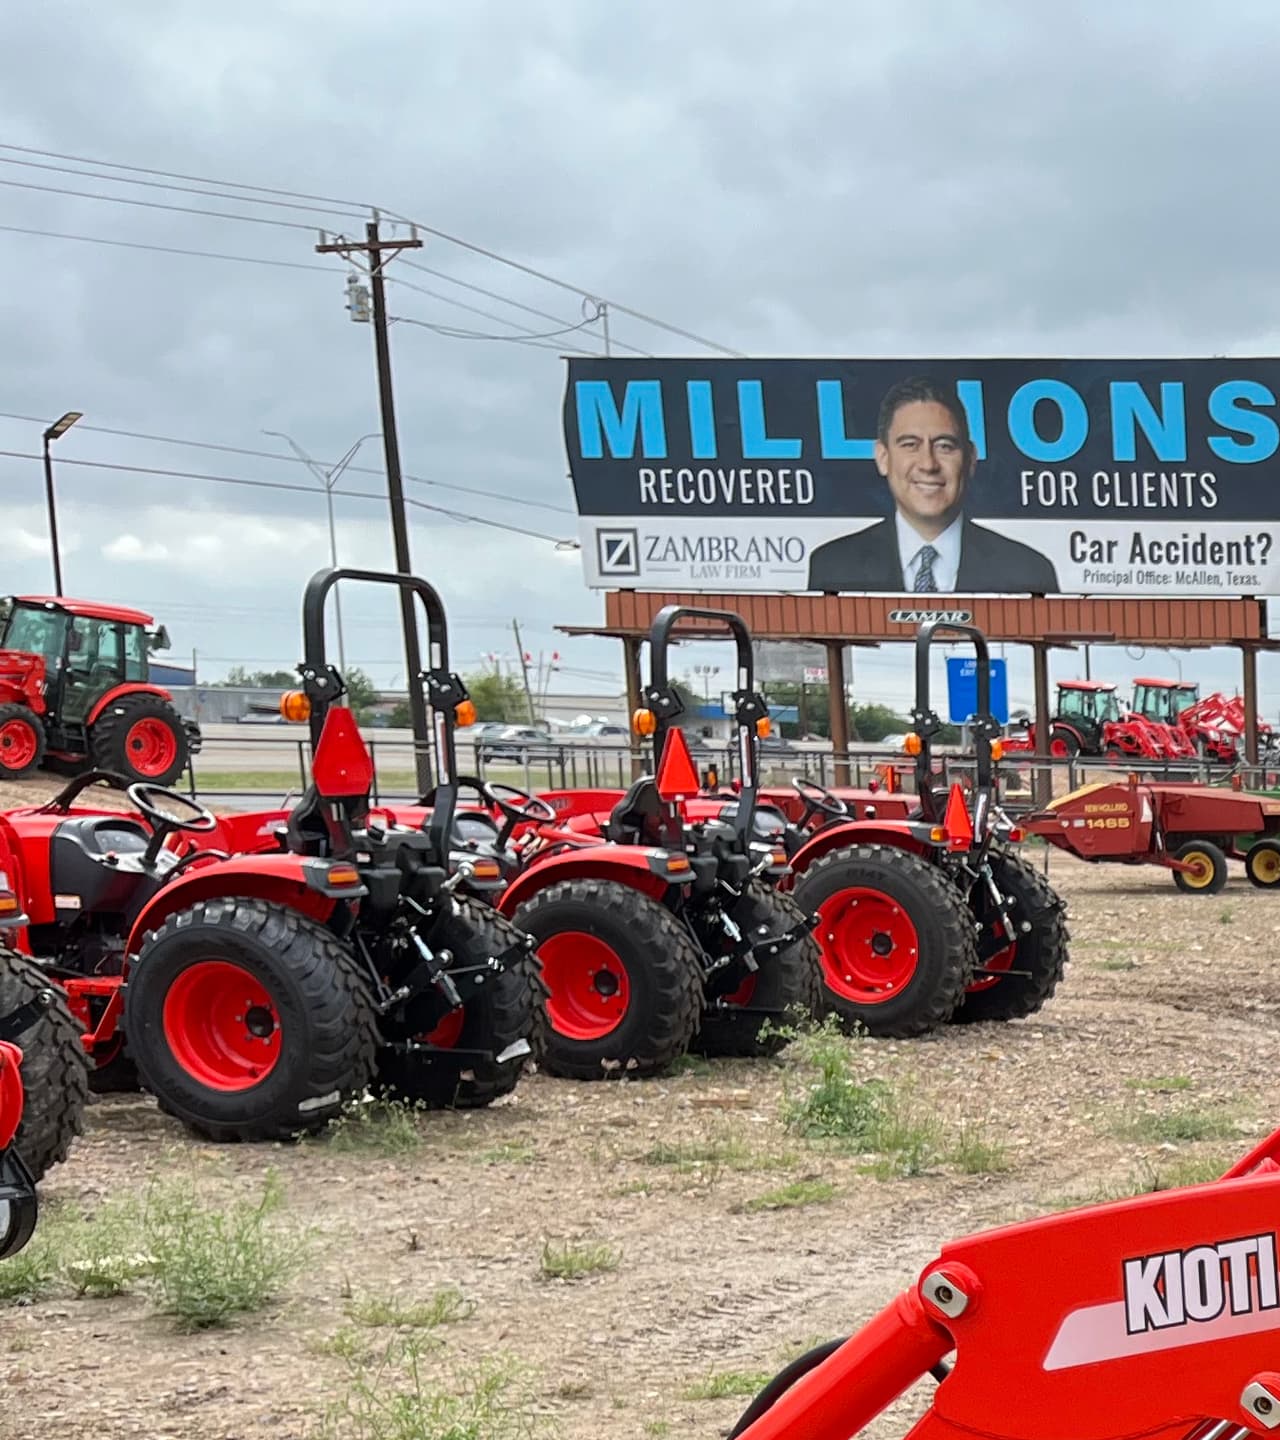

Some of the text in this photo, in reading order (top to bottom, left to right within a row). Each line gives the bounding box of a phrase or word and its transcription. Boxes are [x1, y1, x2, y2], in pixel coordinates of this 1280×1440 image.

[575, 378, 1280, 463] MILLIONS
[638, 468, 1218, 508] RECOVERED FOR CLIENTS
[645, 535, 806, 563] ZAMBRANO
[1069, 530, 1273, 565] Car Accident?
[690, 565, 762, 579] LAW FIRM
[1083, 569, 1133, 586] Principal
[1175, 571, 1223, 587] McAllen,
[1225, 571, 1261, 586] Texas.
[896, 611, 965, 622] LAMAR
[1087, 818, 1130, 828] 1465
[1121, 1231, 1280, 1335] KIOTI
